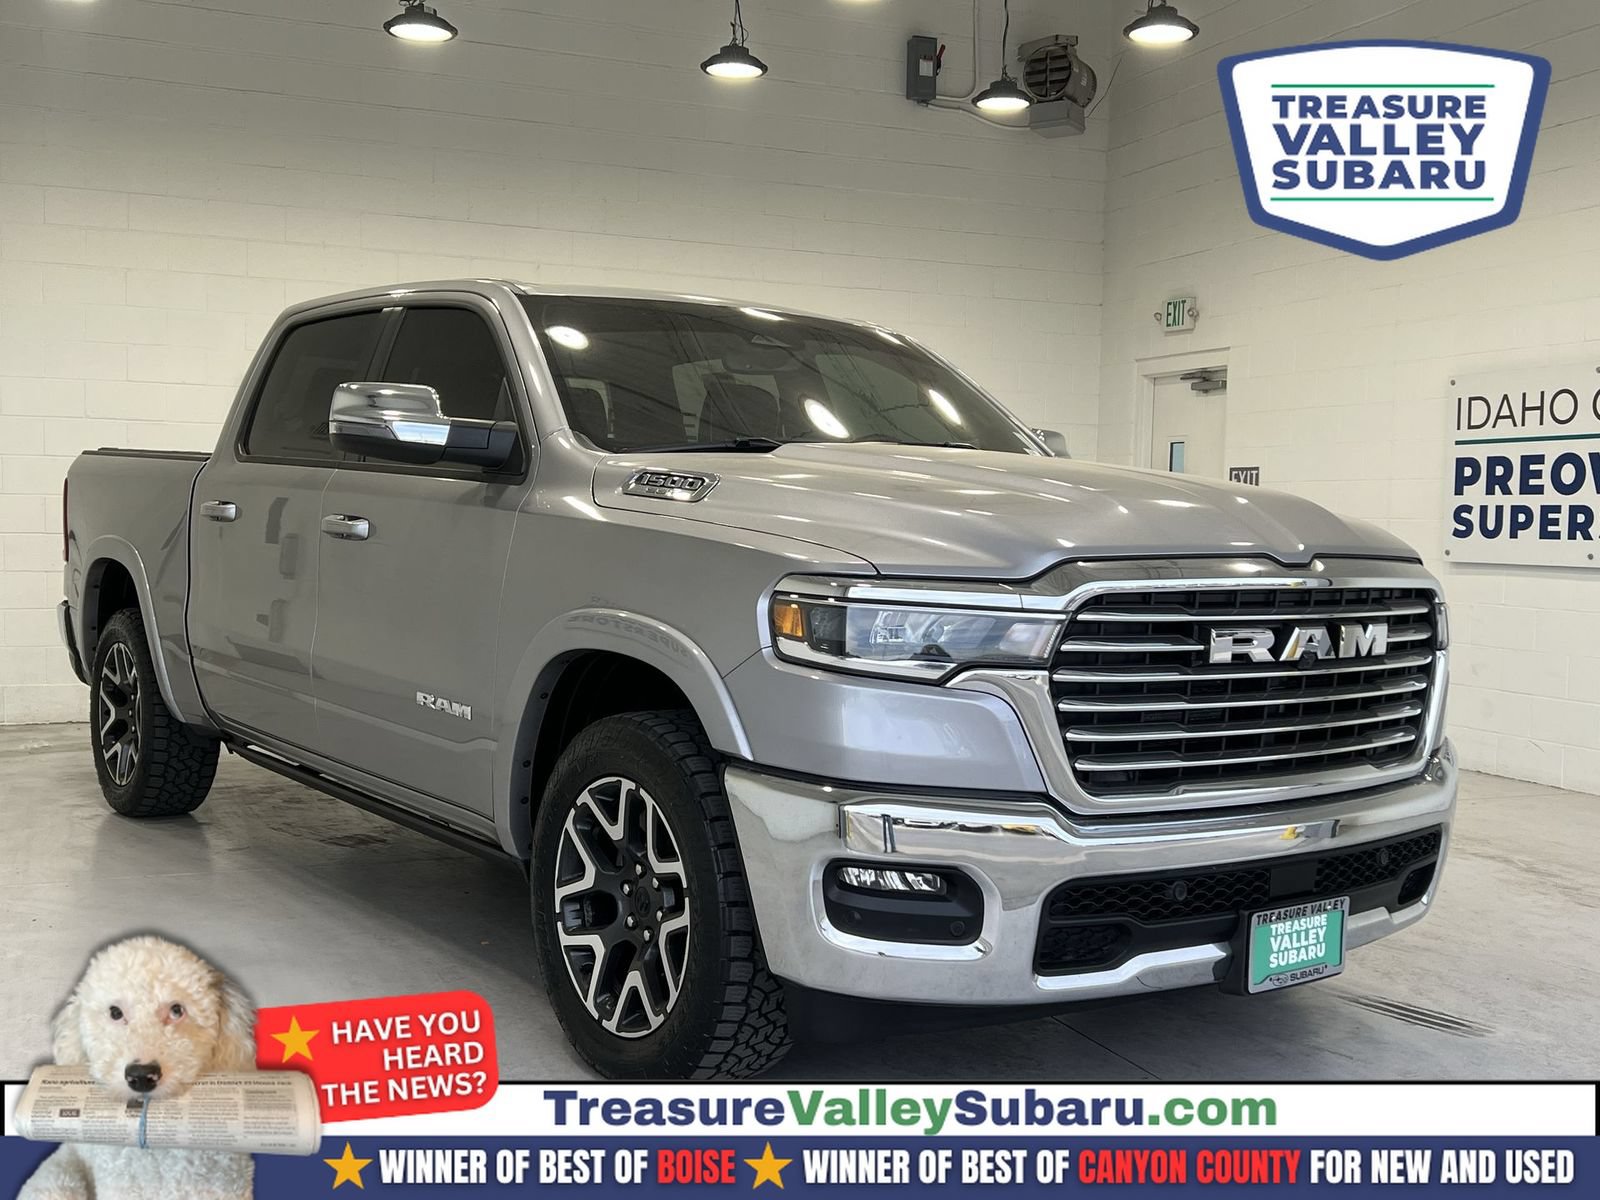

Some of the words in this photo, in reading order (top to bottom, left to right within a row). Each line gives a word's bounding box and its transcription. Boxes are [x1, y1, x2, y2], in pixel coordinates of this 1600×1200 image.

[1166, 299, 1186, 327] EXIT
[1457, 389, 1578, 430] IDAHO
[640, 473, 702, 490] 1500
[1452, 505, 1600, 540] SUPER
[1209, 623, 1388, 663] RAM
[416, 691, 472, 720] RAM
[1256, 907, 1307, 925] TREASURE
[1311, 898, 1346, 916] VALLEY
[1290, 967, 1325, 982] SUBARU
